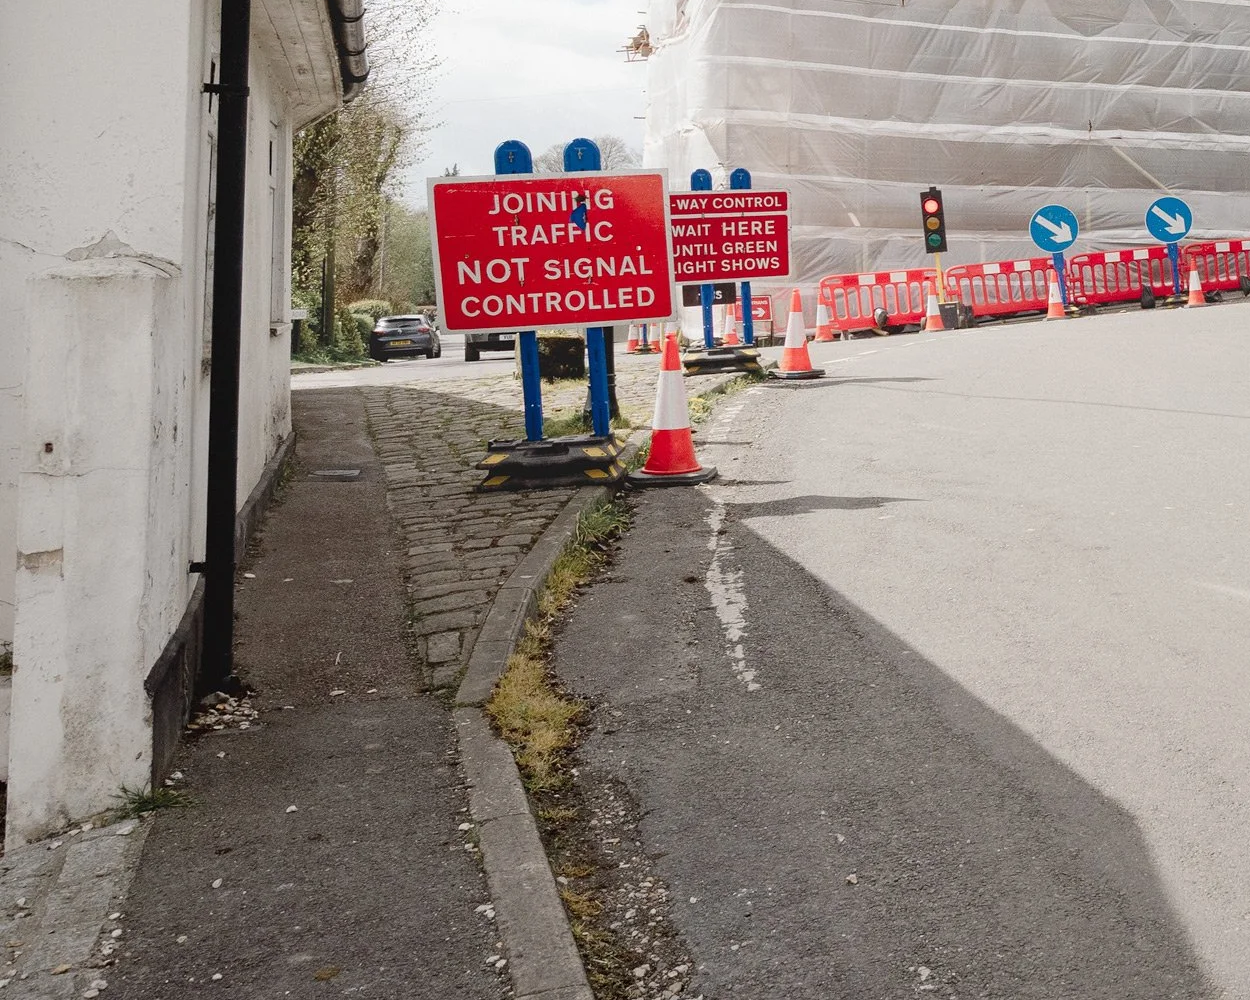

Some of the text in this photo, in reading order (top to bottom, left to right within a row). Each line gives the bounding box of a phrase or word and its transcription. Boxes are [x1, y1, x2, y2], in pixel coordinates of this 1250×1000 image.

[488, 188, 614, 215] JOINING
[671, 196, 782, 210] -WAY CONTROL
[492, 220, 614, 247] TRAFFIC
[671, 220, 776, 237] WAIT HERE
[722, 240, 778, 254] GREEN
[457, 255, 653, 285] NOT SIGNAL
[674, 257, 780, 274] IGHT SHOWS
[460, 286, 655, 317] CONTROLLED
